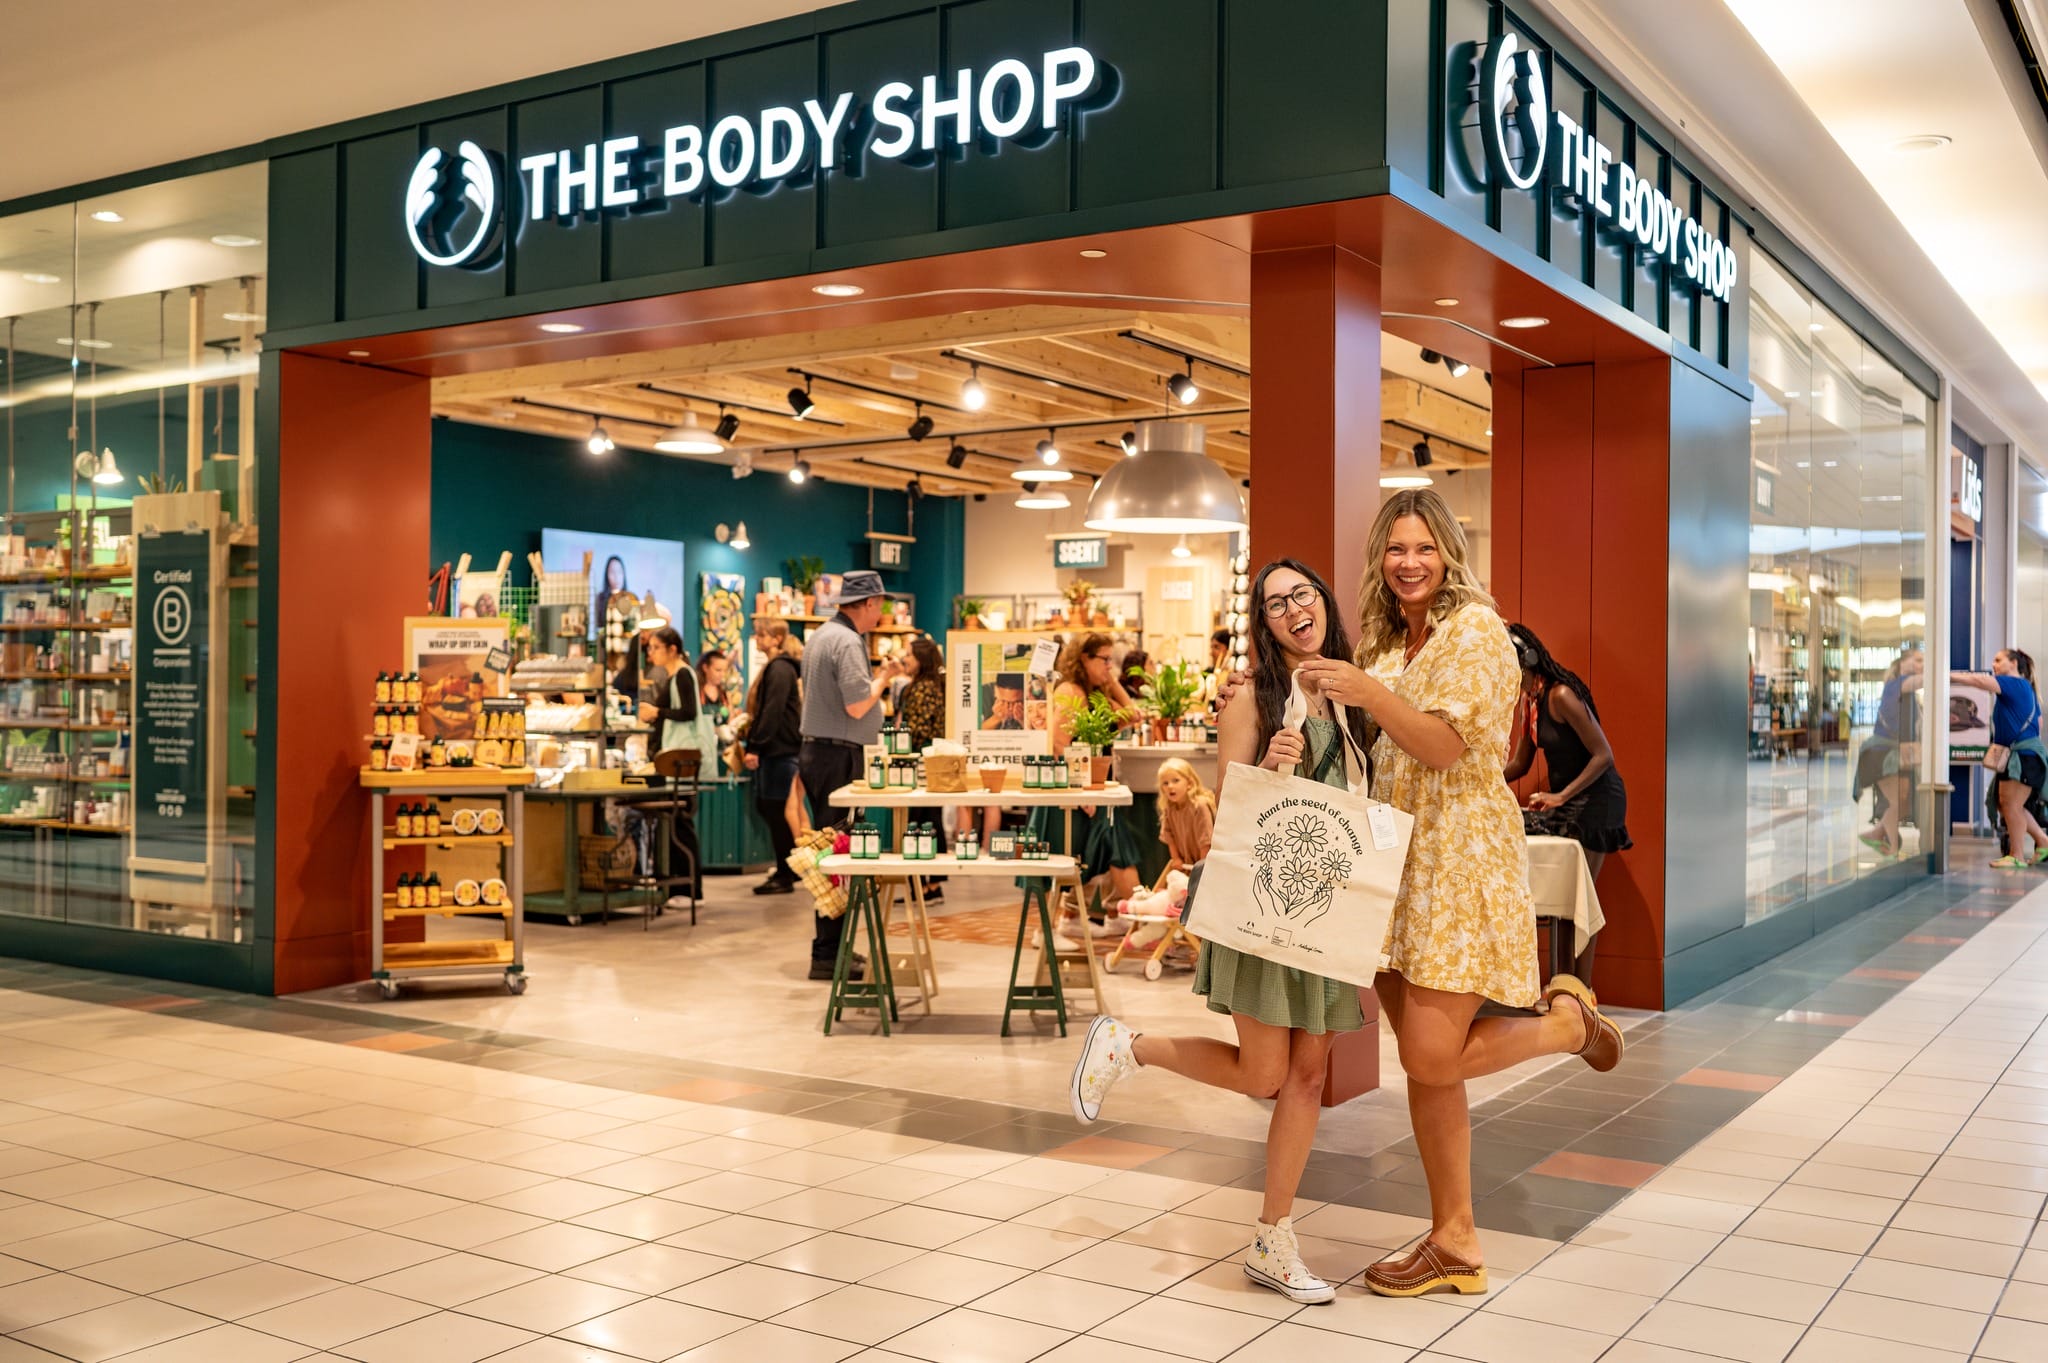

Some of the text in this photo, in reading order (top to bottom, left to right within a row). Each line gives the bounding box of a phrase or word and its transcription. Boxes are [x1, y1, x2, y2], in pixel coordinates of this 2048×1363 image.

[521, 47, 1096, 220] THE BODY SHOP
[1557, 110, 1737, 303] THE BODY SHOP
[880, 542, 901, 565] GIFT
[1059, 541, 1101, 564] SCENT
[153, 569, 192, 583] Certified
[163, 598, 181, 633] B
[429, 640, 488, 648] WRAP UP DRY SKIN
[962, 684, 972, 708] ME
[965, 755, 991, 764] TEA
[1257, 803, 1280, 828] plant
[1281, 797, 1299, 808] the
[1301, 799, 1328, 812] seed
[1328, 808, 1341, 819] of
[1338, 817, 1363, 856] change
